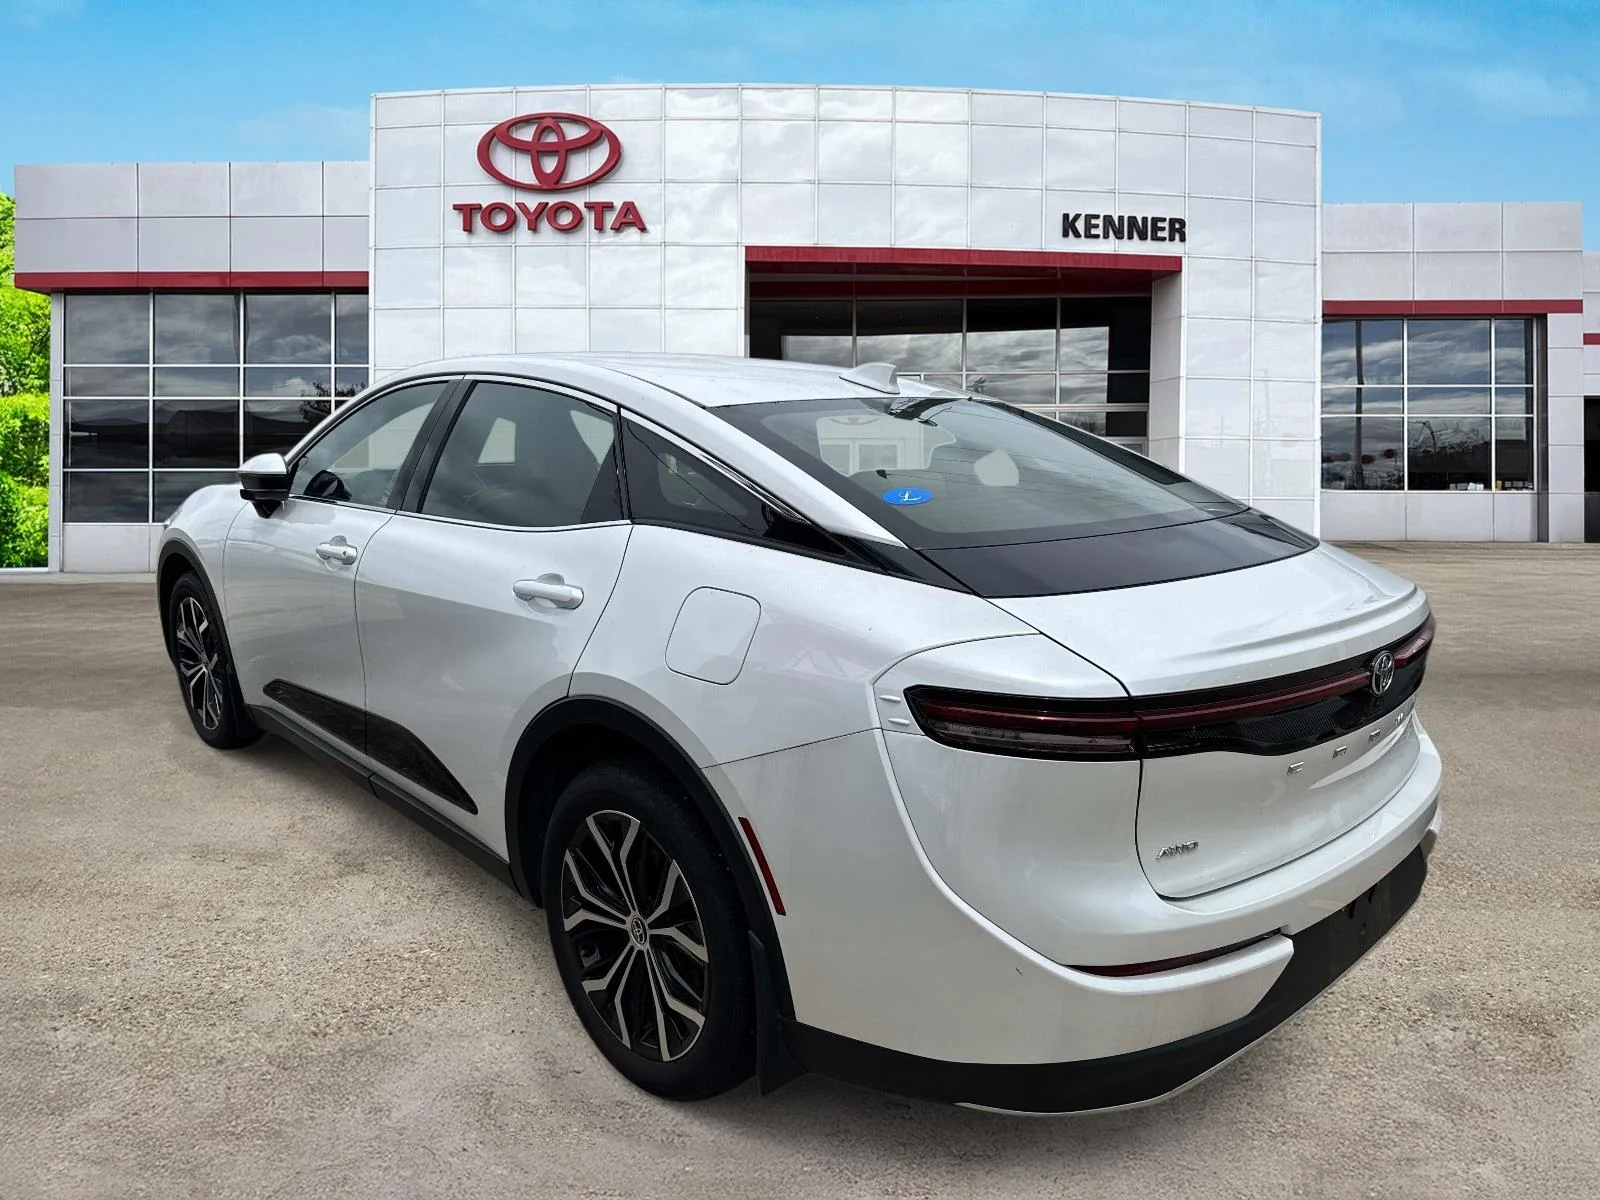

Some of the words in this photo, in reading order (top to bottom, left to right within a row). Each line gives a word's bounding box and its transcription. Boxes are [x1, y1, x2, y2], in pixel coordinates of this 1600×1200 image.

[453, 201, 648, 233] TOYOTA
[1062, 213, 1187, 242] KENNER
[1155, 840, 1199, 860] AWD
